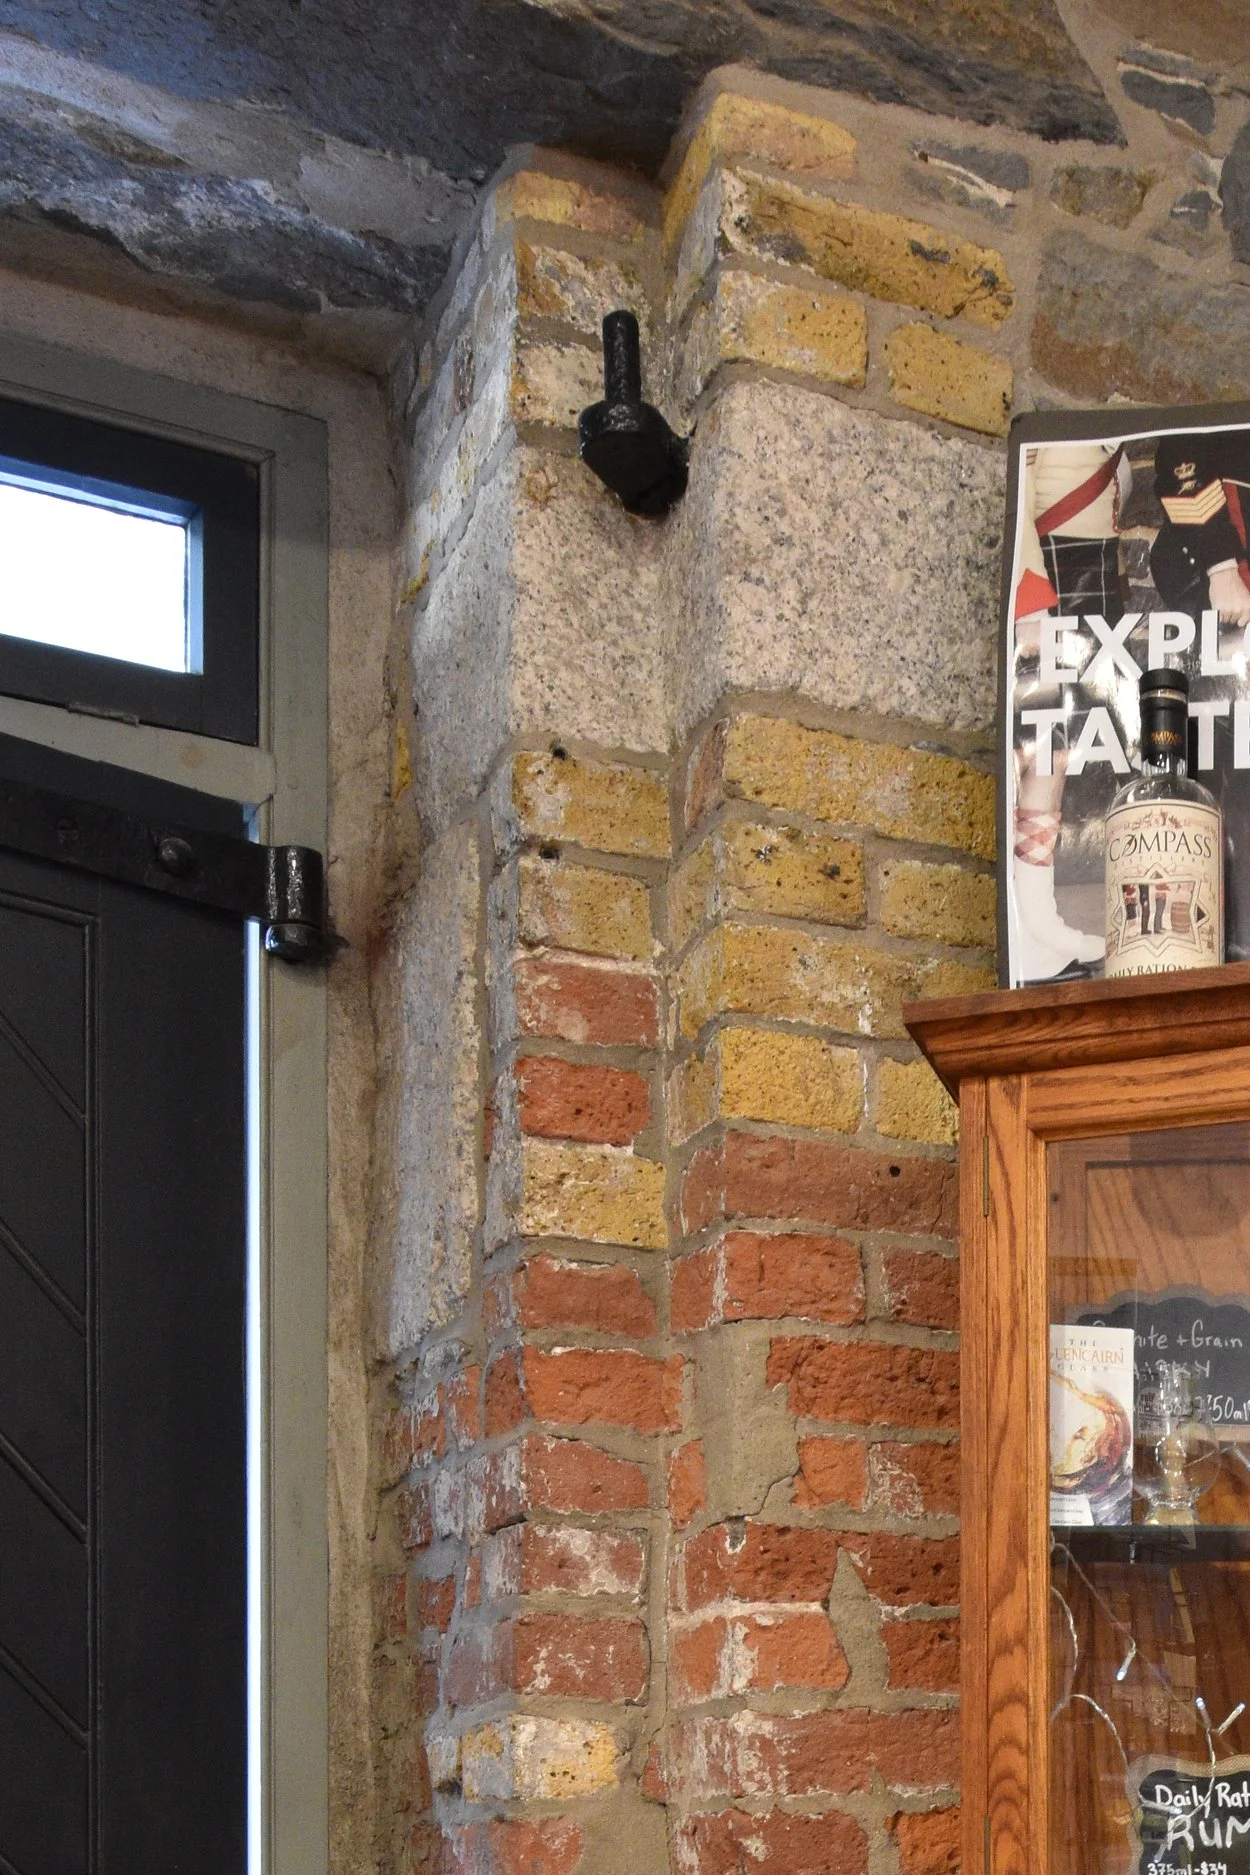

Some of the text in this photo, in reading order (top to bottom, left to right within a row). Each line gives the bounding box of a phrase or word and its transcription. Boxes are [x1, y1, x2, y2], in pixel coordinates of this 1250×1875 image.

[1109, 829, 1213, 862] COMPASS
[1191, 1320, 1244, 1349] Grain
[1155, 1784, 1211, 1818] Daily
